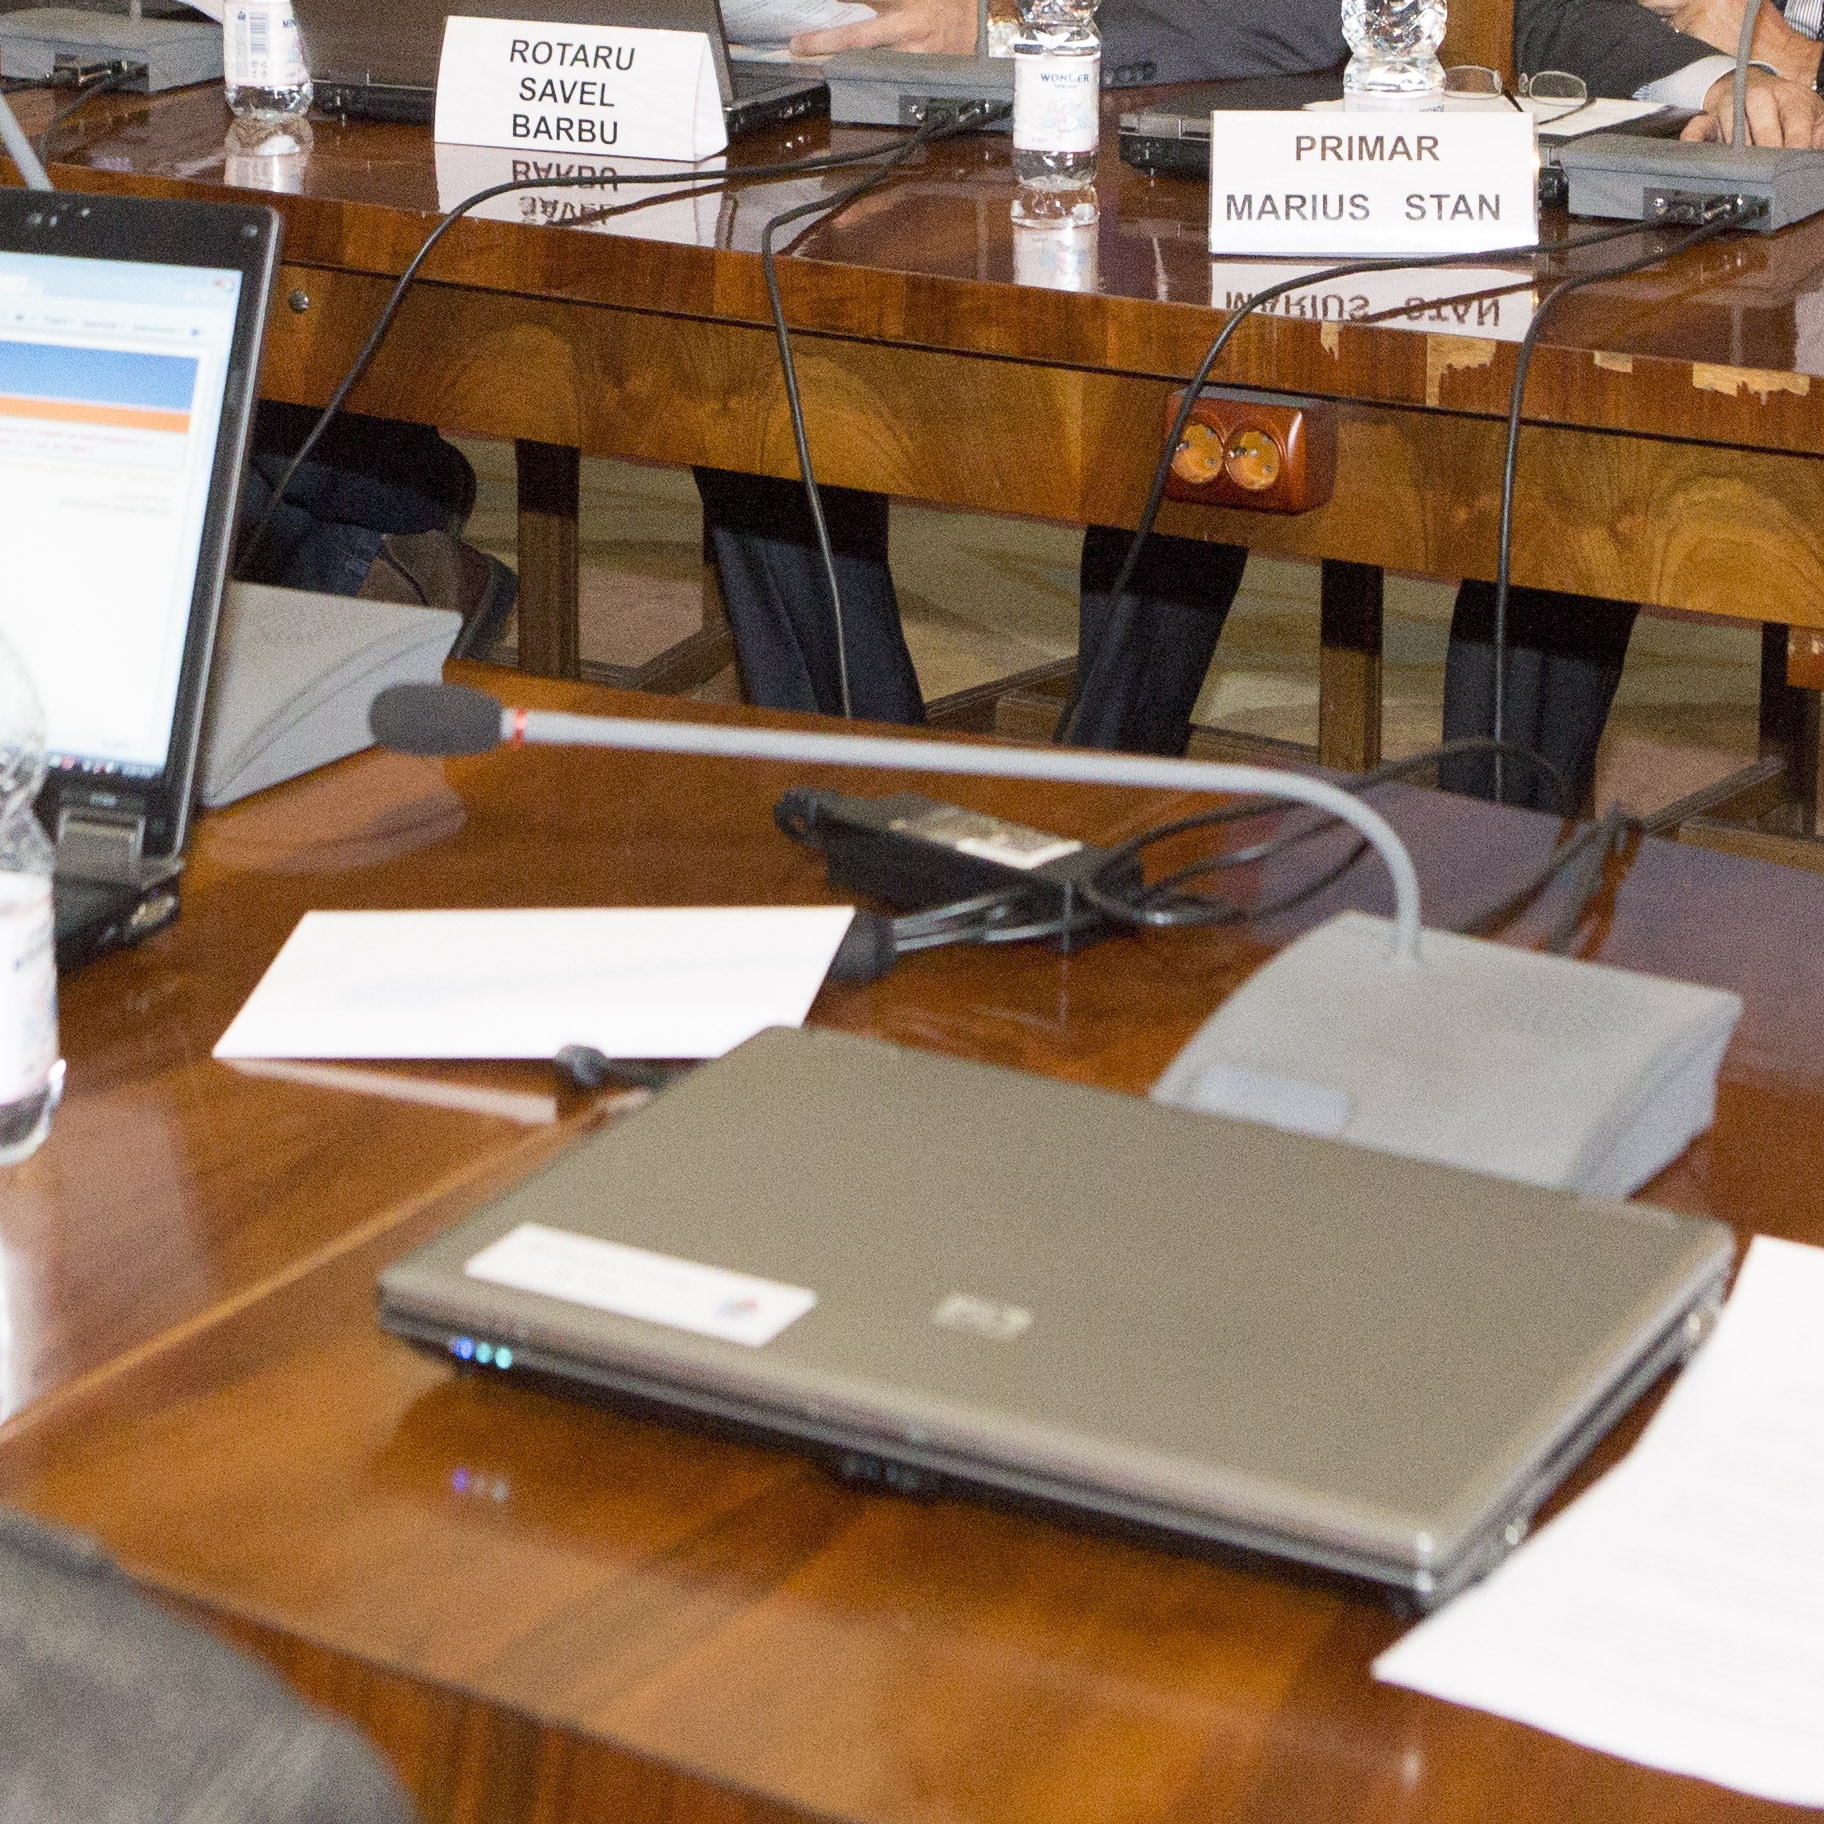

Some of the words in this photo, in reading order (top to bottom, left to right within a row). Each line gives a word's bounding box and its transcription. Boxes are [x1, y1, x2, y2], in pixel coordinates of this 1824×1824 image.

[509, 39, 635, 71] ROTARU
[518, 77, 615, 107] SAVEL
[512, 114, 618, 145] BARBU
[1295, 135, 1440, 161] PRIMAR
[1225, 193, 1371, 221] MARIUS
[1404, 193, 1501, 221] STAN
